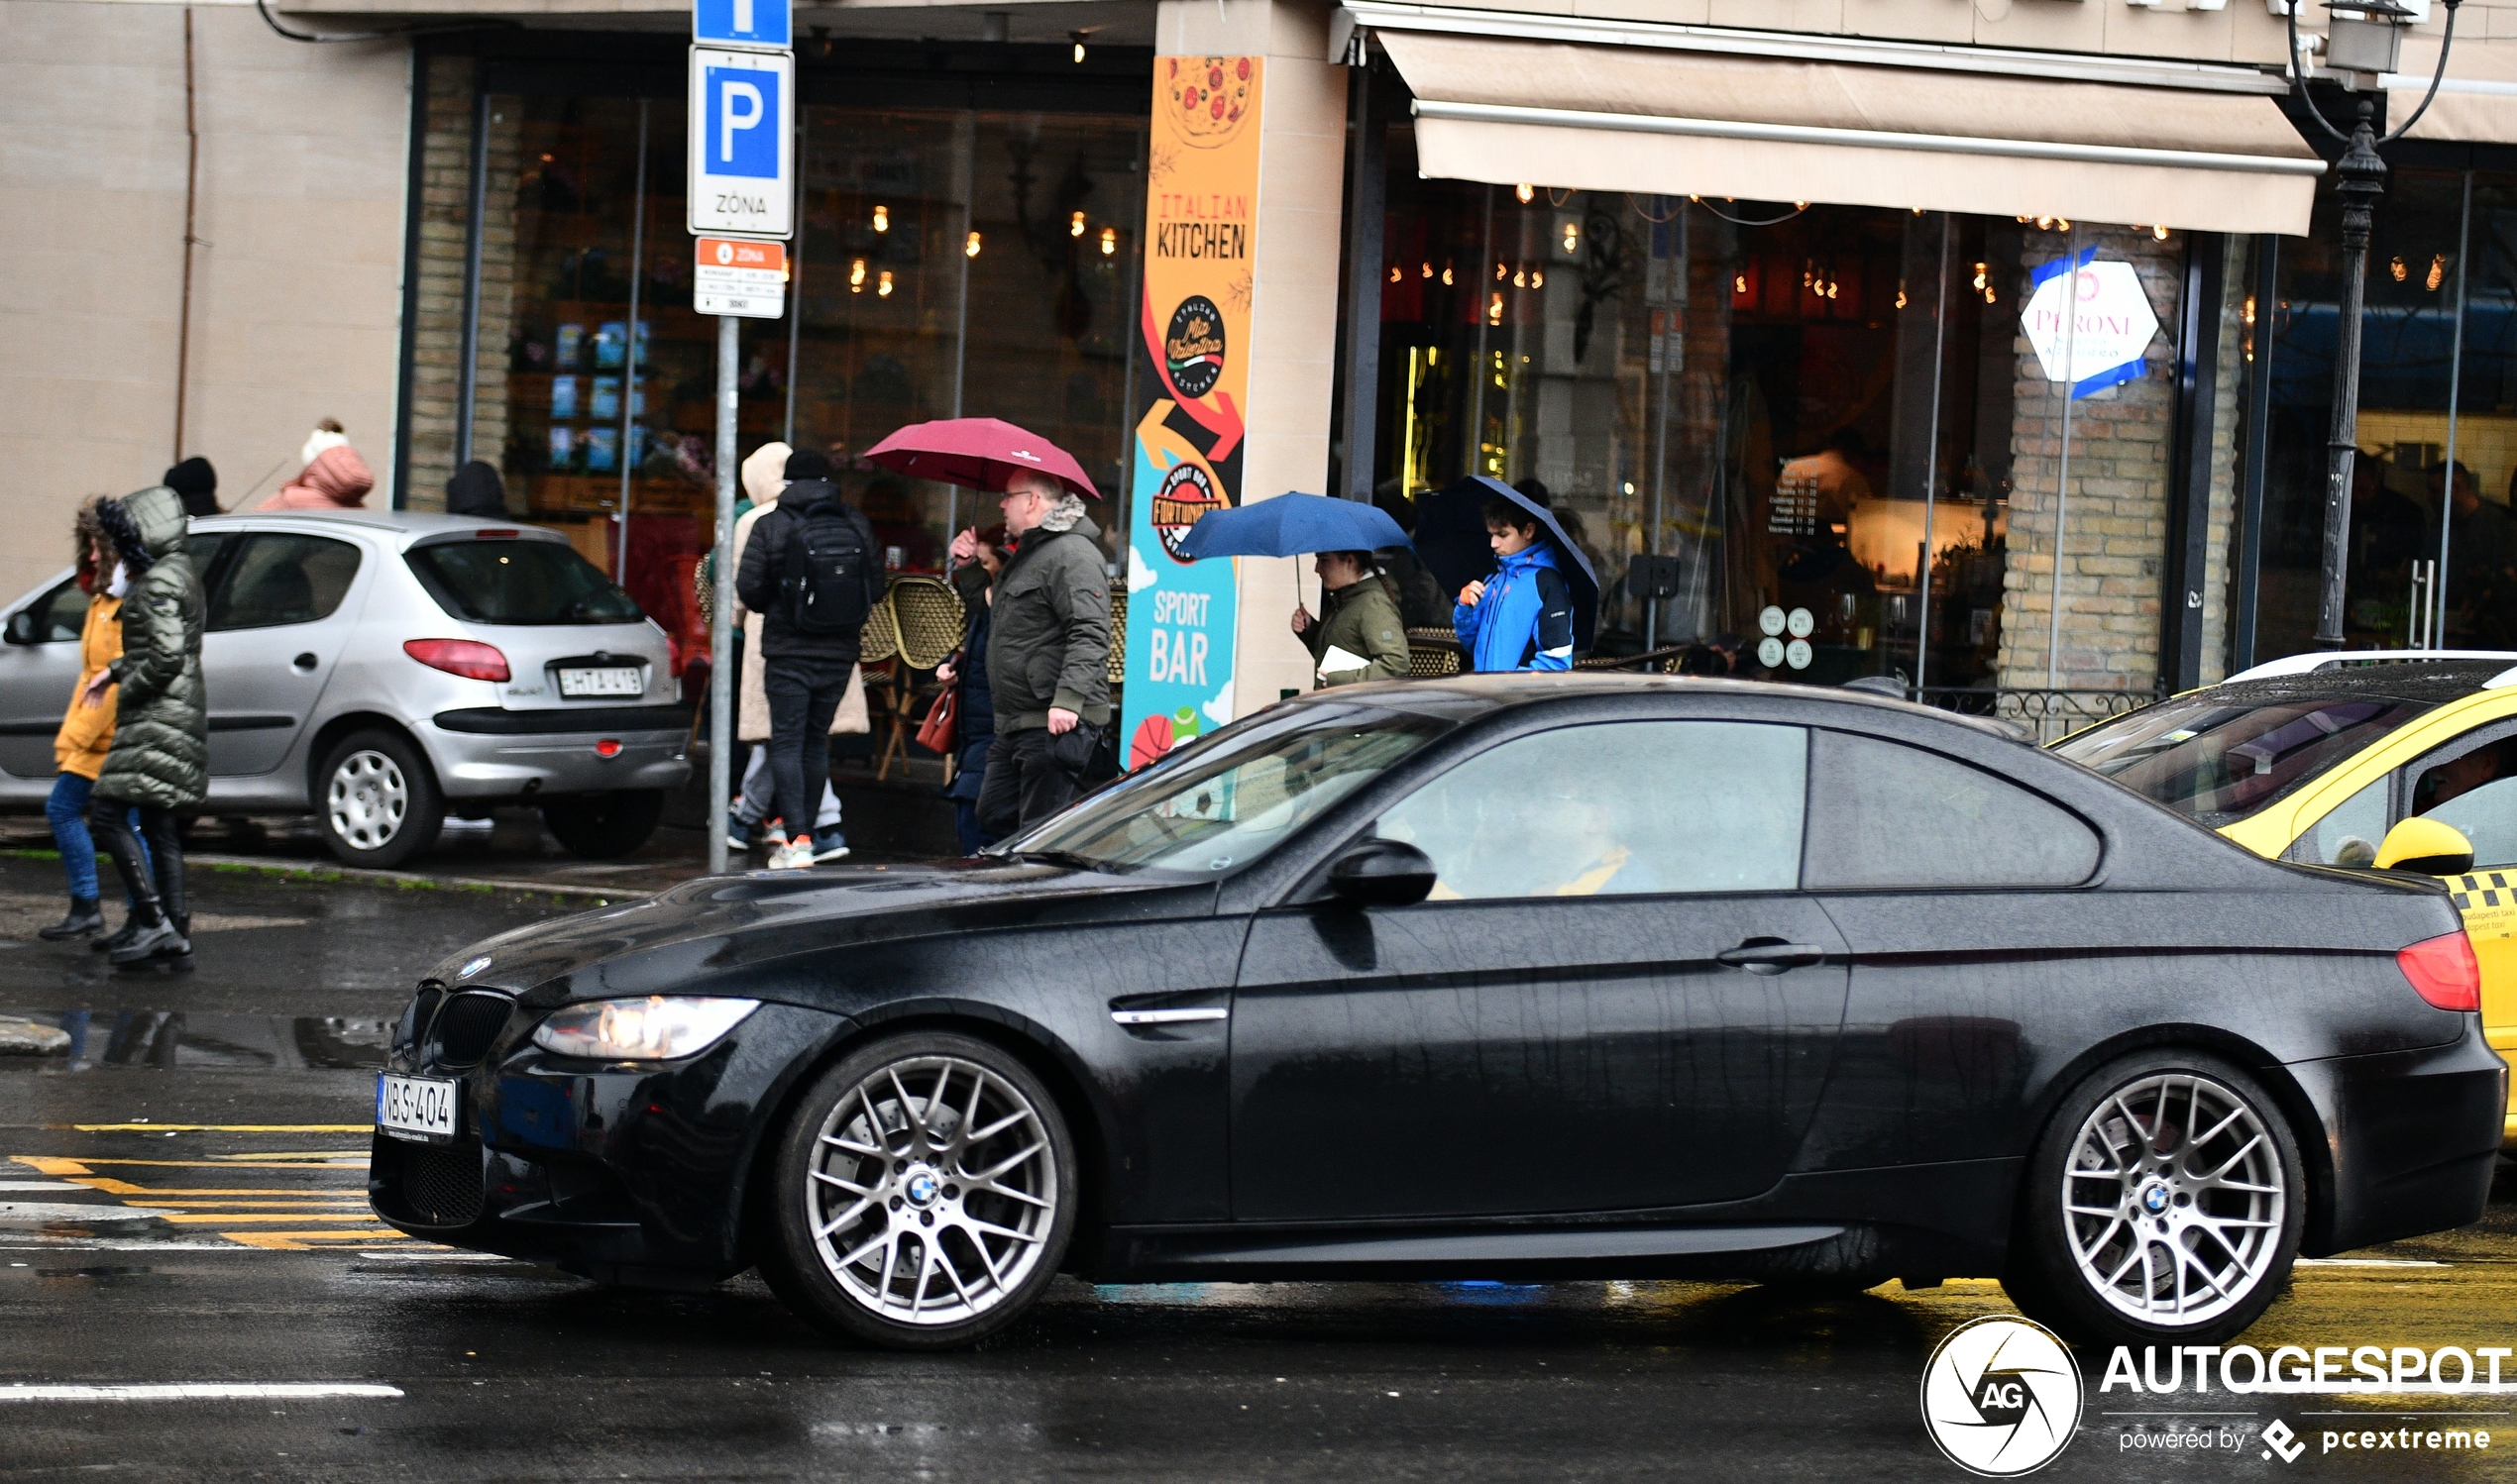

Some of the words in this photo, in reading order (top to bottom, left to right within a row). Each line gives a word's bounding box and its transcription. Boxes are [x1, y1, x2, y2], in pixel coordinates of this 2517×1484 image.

[720, 80, 764, 162] P
[715, 190, 768, 216] ZÓNA
[1160, 194, 1248, 220] ITALIAN
[1157, 222, 1246, 260] KITCHEN
[2036, 309, 2129, 335] PERONI
[1153, 589, 1211, 628] SPORT
[1149, 627, 1209, 687] BAR
[2491, 920, 2505, 929] taxi
[2501, 907, 2516, 917] taxi
